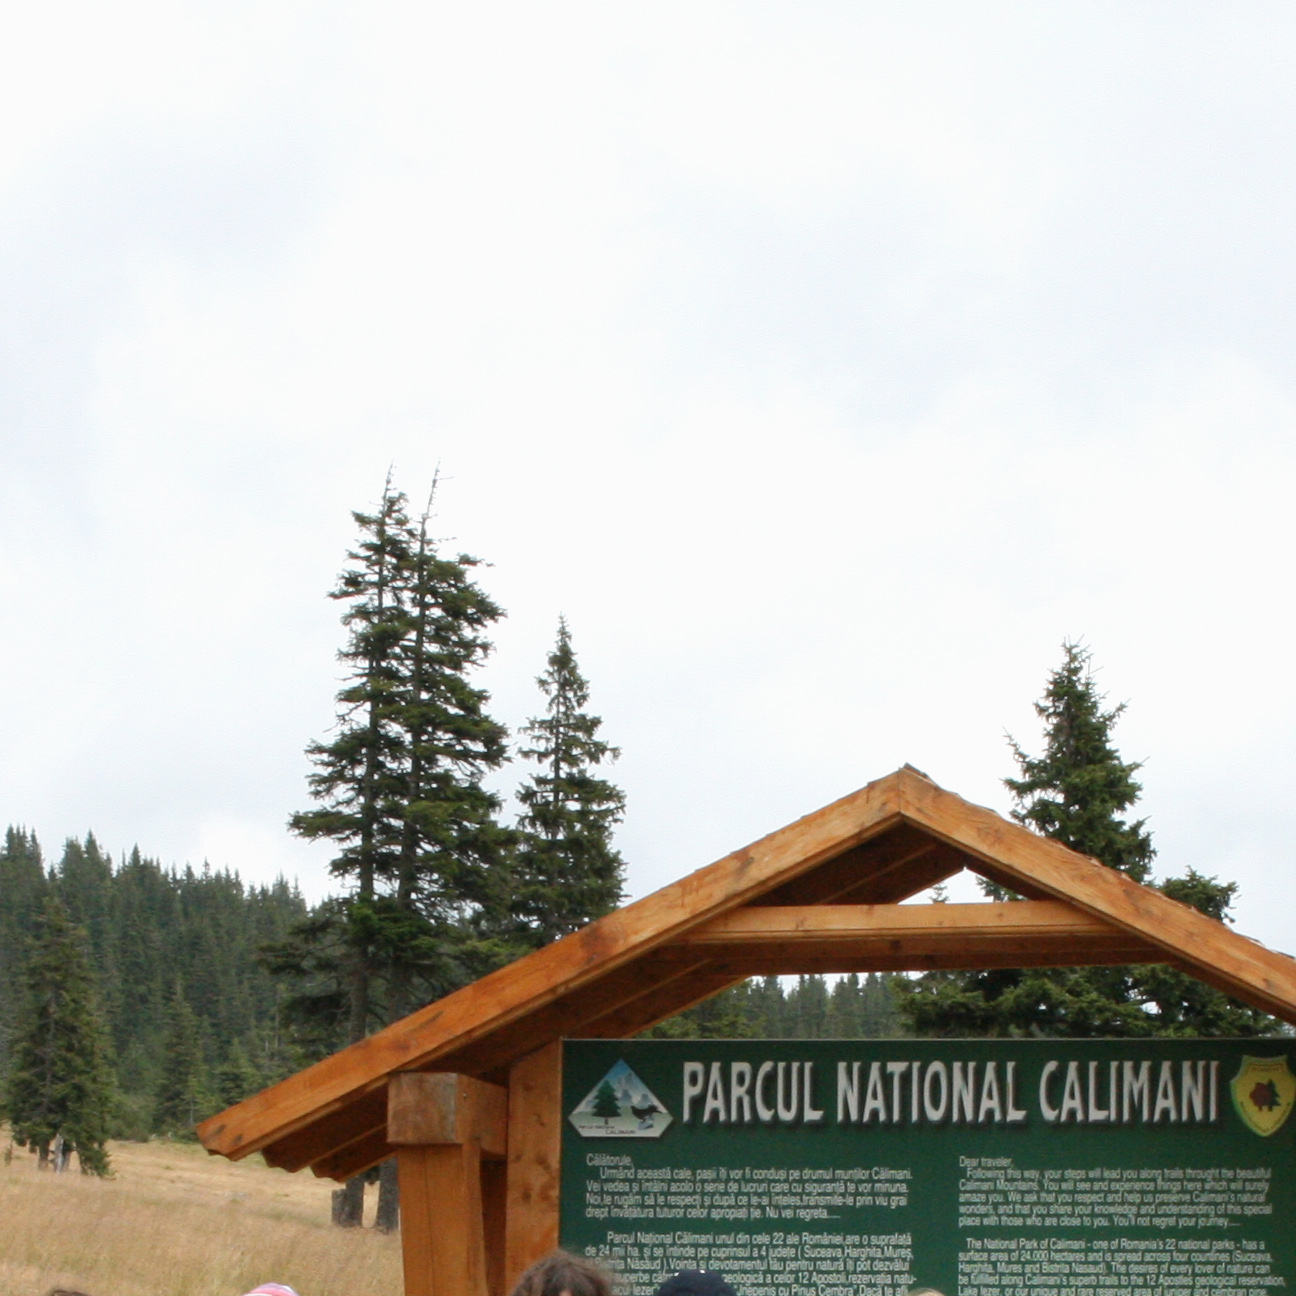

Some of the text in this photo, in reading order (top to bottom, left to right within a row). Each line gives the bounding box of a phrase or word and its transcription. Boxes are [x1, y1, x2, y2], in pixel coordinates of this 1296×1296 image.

[682, 1061, 824, 1123] PARCUL
[836, 1061, 1027, 1123] NATIONAL
[1039, 1061, 1221, 1122] CALIMANI
